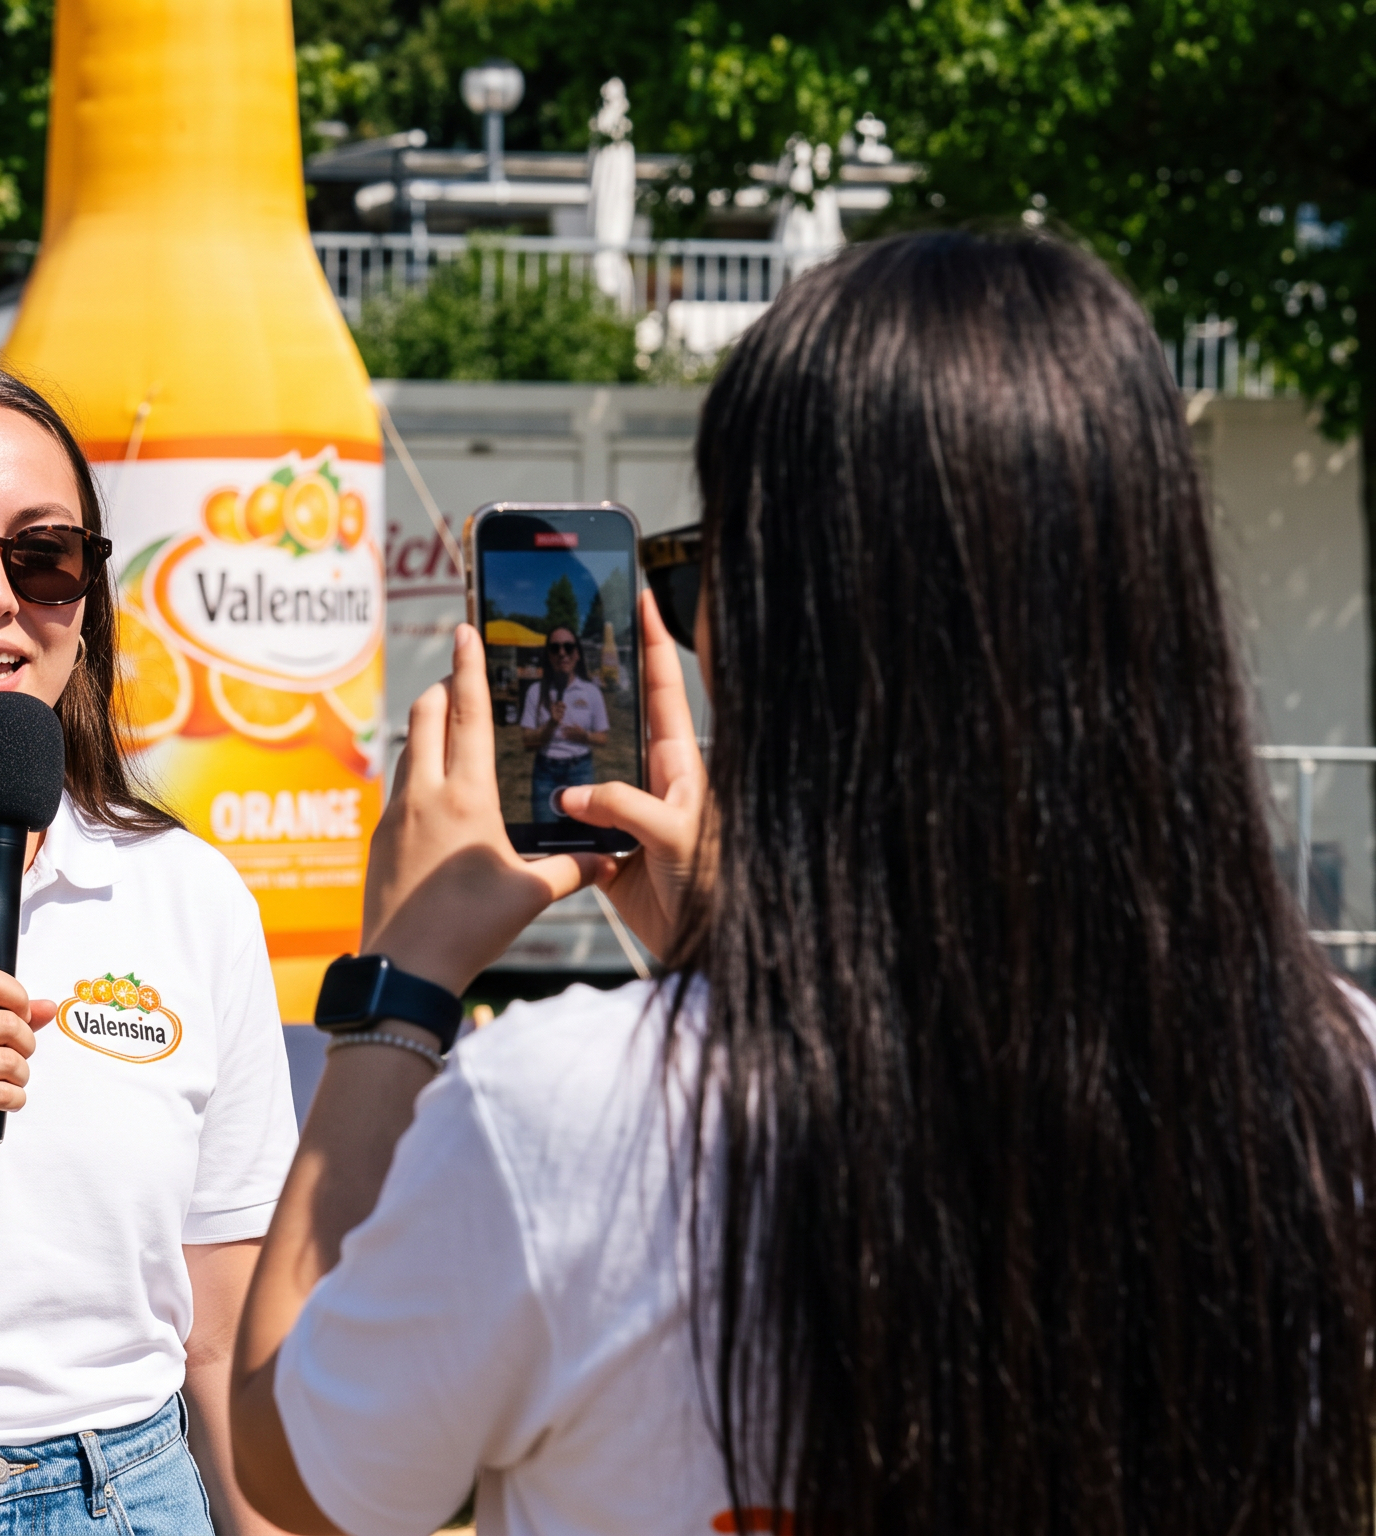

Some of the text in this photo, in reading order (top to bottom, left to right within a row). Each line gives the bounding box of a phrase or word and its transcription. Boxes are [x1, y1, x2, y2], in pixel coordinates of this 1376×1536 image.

[197, 566, 369, 623] Valensina
[210, 788, 362, 842] ORANGE
[74, 1011, 166, 1044] Valensina
